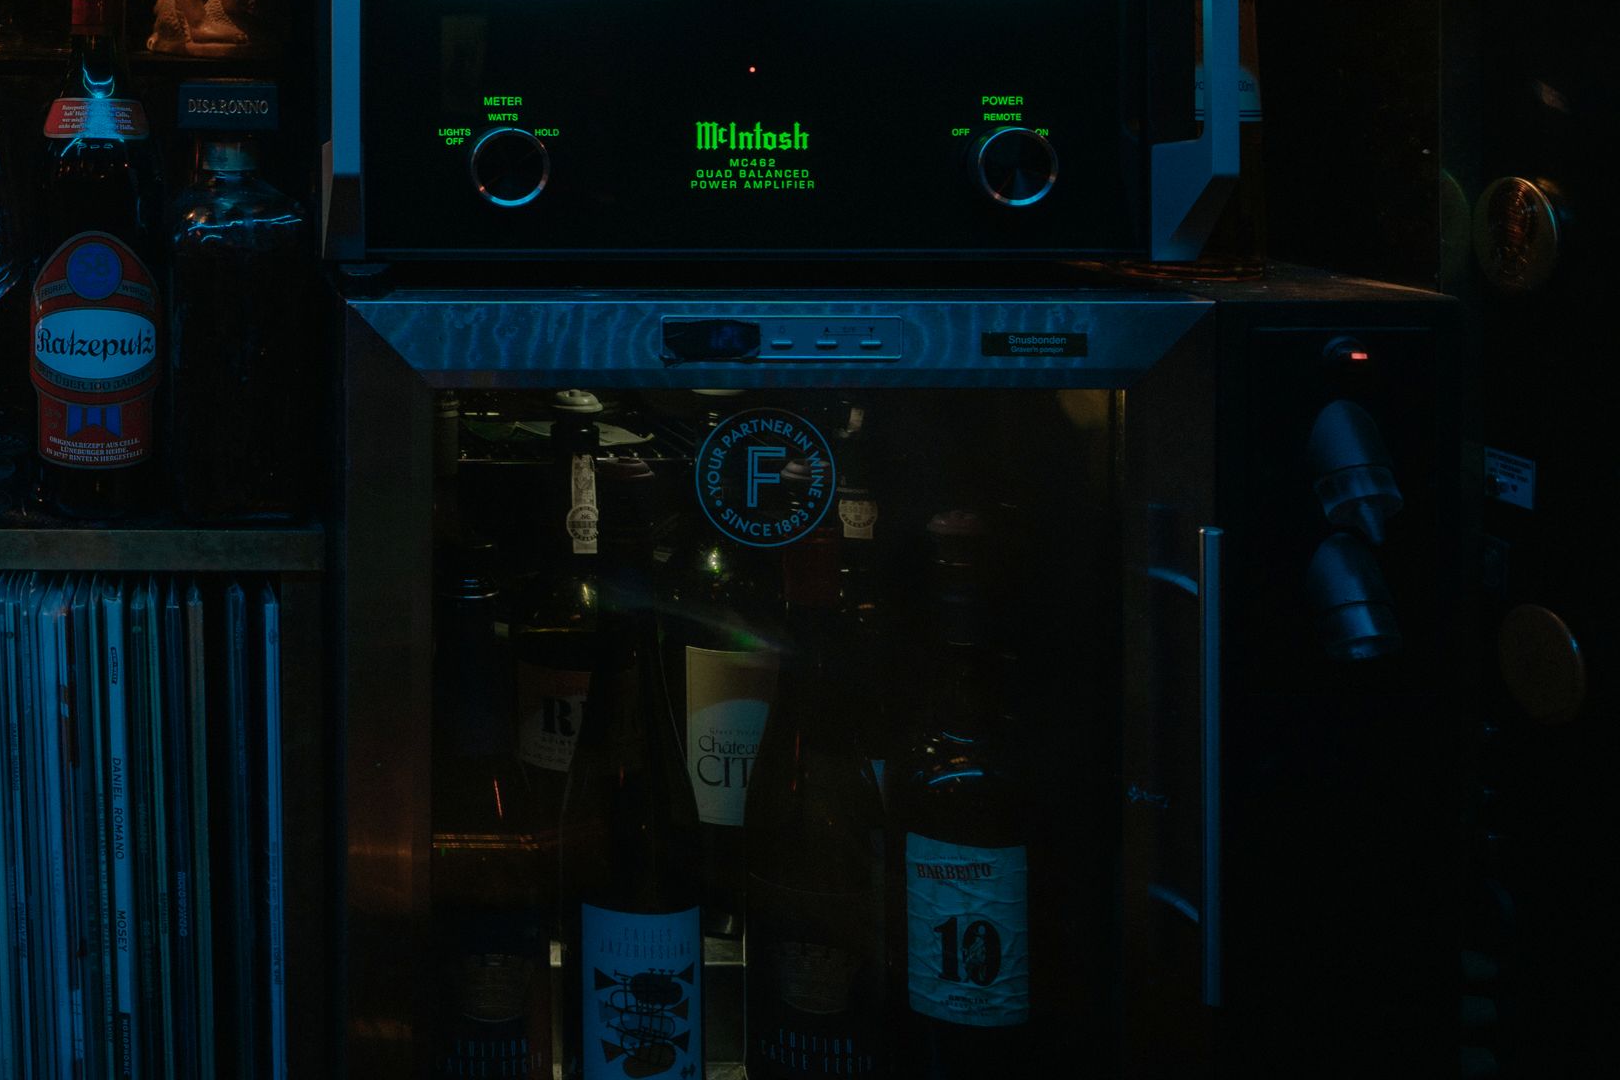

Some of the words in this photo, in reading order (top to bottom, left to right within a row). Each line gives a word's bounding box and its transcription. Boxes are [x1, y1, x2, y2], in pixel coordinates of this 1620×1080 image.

[483, 96, 523, 107] METER
[981, 95, 1024, 106] POWER
[187, 98, 269, 116] DISARONNO
[487, 113, 519, 121] WATTS
[983, 113, 1022, 121] REMOTE
[438, 128, 471, 137] LIGHTS
[534, 128, 560, 137] HOLD
[695, 120, 810, 151] McIntosh
[951, 128, 970, 136] OFF
[1035, 128, 1049, 137] ON
[445, 137, 464, 146] OFF
[729, 158, 776, 167] MC462
[696, 169, 732, 178] QUAD
[739, 169, 810, 178] BALANCED
[690, 180, 738, 189] POWER
[743, 180, 815, 189] AMPLIFIER
[37, 327, 154, 363] Ratzeputz
[1008, 334, 1068, 346] Snusbonden
[60, 445, 105, 455] LÜNEBURGER
[707, 446, 727, 496] YOUR
[721, 418, 794, 449] PARTNER
[792, 431, 813, 452] IN
[806, 450, 825, 499] WINE
[746, 445, 787, 508] F
[721, 507, 773, 537] SINCE
[773, 508, 809, 535] 1893
[111, 757, 125, 803] DANIEL
[113, 807, 126, 861] ROMANO
[917, 863, 993, 880] BARBEITO
[115, 910, 129, 953] MOSEY
[934, 916, 1002, 987] 10
[122, 1018, 131, 1076] MONOPHONIC
